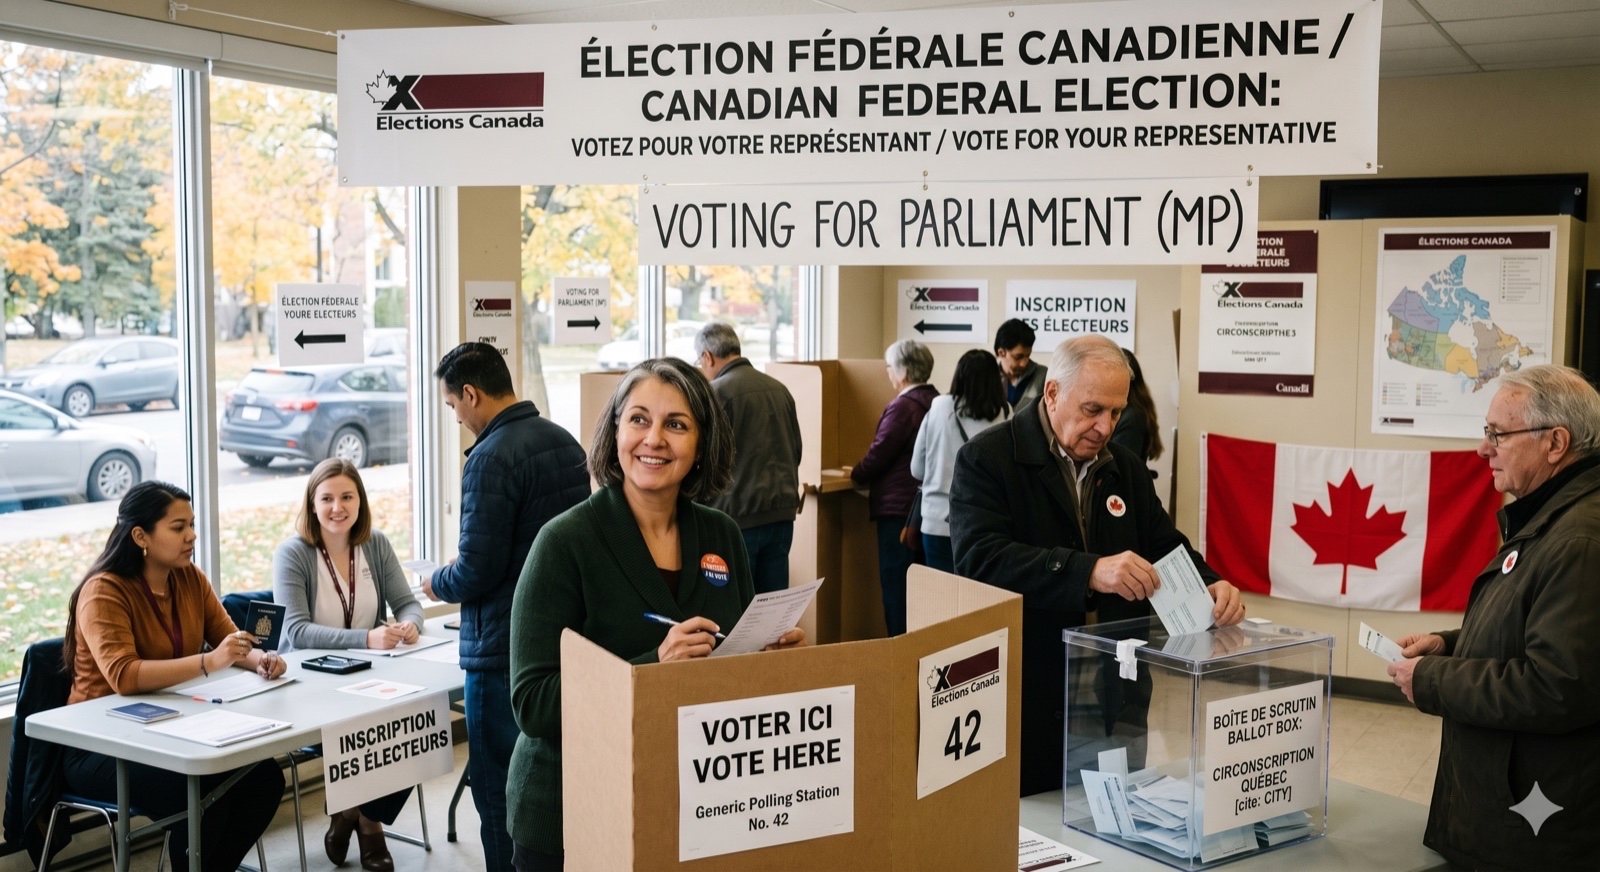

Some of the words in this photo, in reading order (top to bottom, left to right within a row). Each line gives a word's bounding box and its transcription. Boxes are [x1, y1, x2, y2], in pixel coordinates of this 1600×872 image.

[580, 36, 773, 79] ÉLECTION
[789, 26, 1004, 73] FÉDÉRALE
[1018, 18, 1320, 66] CANADIENNE
[1329, 13, 1354, 59] /
[641, 86, 838, 122] CANADIAN
[858, 79, 1041, 117] FEDERAL
[1054, 72, 1281, 112] ELECTION:
[376, 115, 464, 130] Elections
[469, 113, 544, 129] Canada
[572, 138, 633, 157] VOTEZ
[639, 136, 694, 156] POUR
[699, 135, 764, 155] VOTRE
[770, 128, 932, 154] REPRÉSENTANT
[935, 129, 947, 155] /
[952, 130, 1008, 151] VOTE
[1015, 128, 1059, 150] FOR
[1065, 127, 1127, 149] YOUR
[1134, 121, 1337, 147] REPRESENTATIVE
[653, 202, 795, 248] VOTING
[816, 200, 880, 248] FOR
[900, 197, 1141, 248] PARLIAMENT
[1157, 188, 1244, 254] (MP)
[1418, 237, 1469, 246] ÉLECTIONS
[1471, 237, 1512, 245] CANADA
[281, 295, 320, 306] ÉLECTION
[566, 288, 587, 296] VOTING
[588, 288, 599, 296] FOR
[1015, 297, 1125, 313] INSCRIPTION
[1217, 300, 1262, 308] Elections
[1264, 300, 1303, 308] Canada
[1043, 315, 1129, 333] ÉLECTEURS
[931, 686, 969, 708] Elections
[970, 674, 1000, 694] Canada
[702, 711, 790, 746] VOTER
[800, 704, 832, 733] ICI
[1213, 709, 1248, 730] BOÎTE
[1251, 707, 1267, 722] DE
[1269, 696, 1317, 718] SCRUTIN
[339, 709, 436, 755] INSCRIPTION
[944, 709, 982, 761] 42
[1228, 724, 1273, 745] BALLOT
[1276, 717, 1302, 735] BOX:
[329, 757, 360, 784] DES
[364, 729, 448, 772] ÉLECTEURS
[693, 750, 764, 783] VOTE
[773, 738, 841, 772] HERE
[1213, 746, 1315, 782] CIRCONSCRIPTION
[1241, 769, 1288, 794] QUÉBEC
[695, 800, 746, 819] Generic
[749, 791, 793, 811] Polling
[796, 786, 840, 803] Station
[1235, 795, 1261, 816] [cite:
[1264, 786, 1292, 806] CITY]
[749, 817, 769, 831] No.
[773, 813, 789, 826] 42
